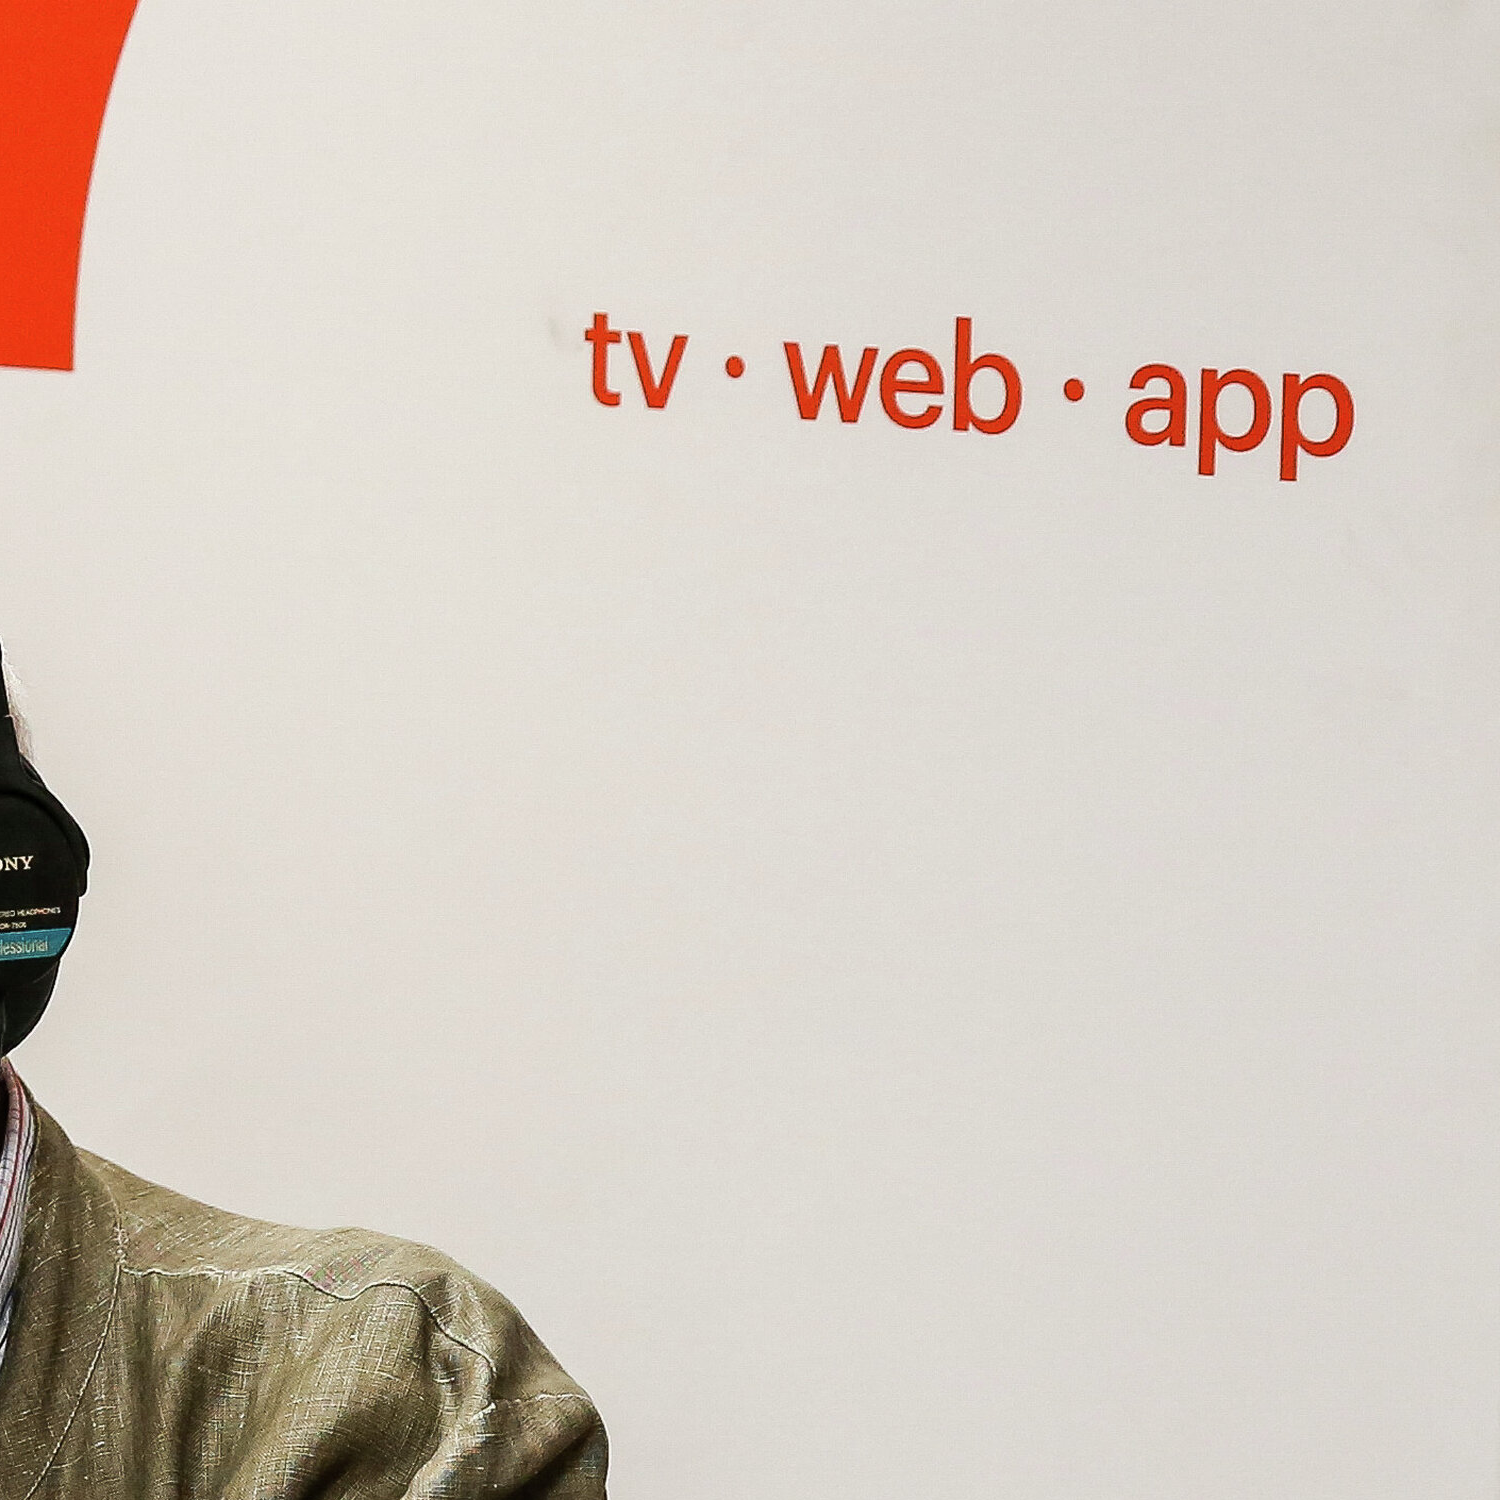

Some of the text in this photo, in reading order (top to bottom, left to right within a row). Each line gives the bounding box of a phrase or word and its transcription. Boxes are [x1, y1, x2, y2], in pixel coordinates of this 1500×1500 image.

[584, 311, 1356, 481] tv web app
